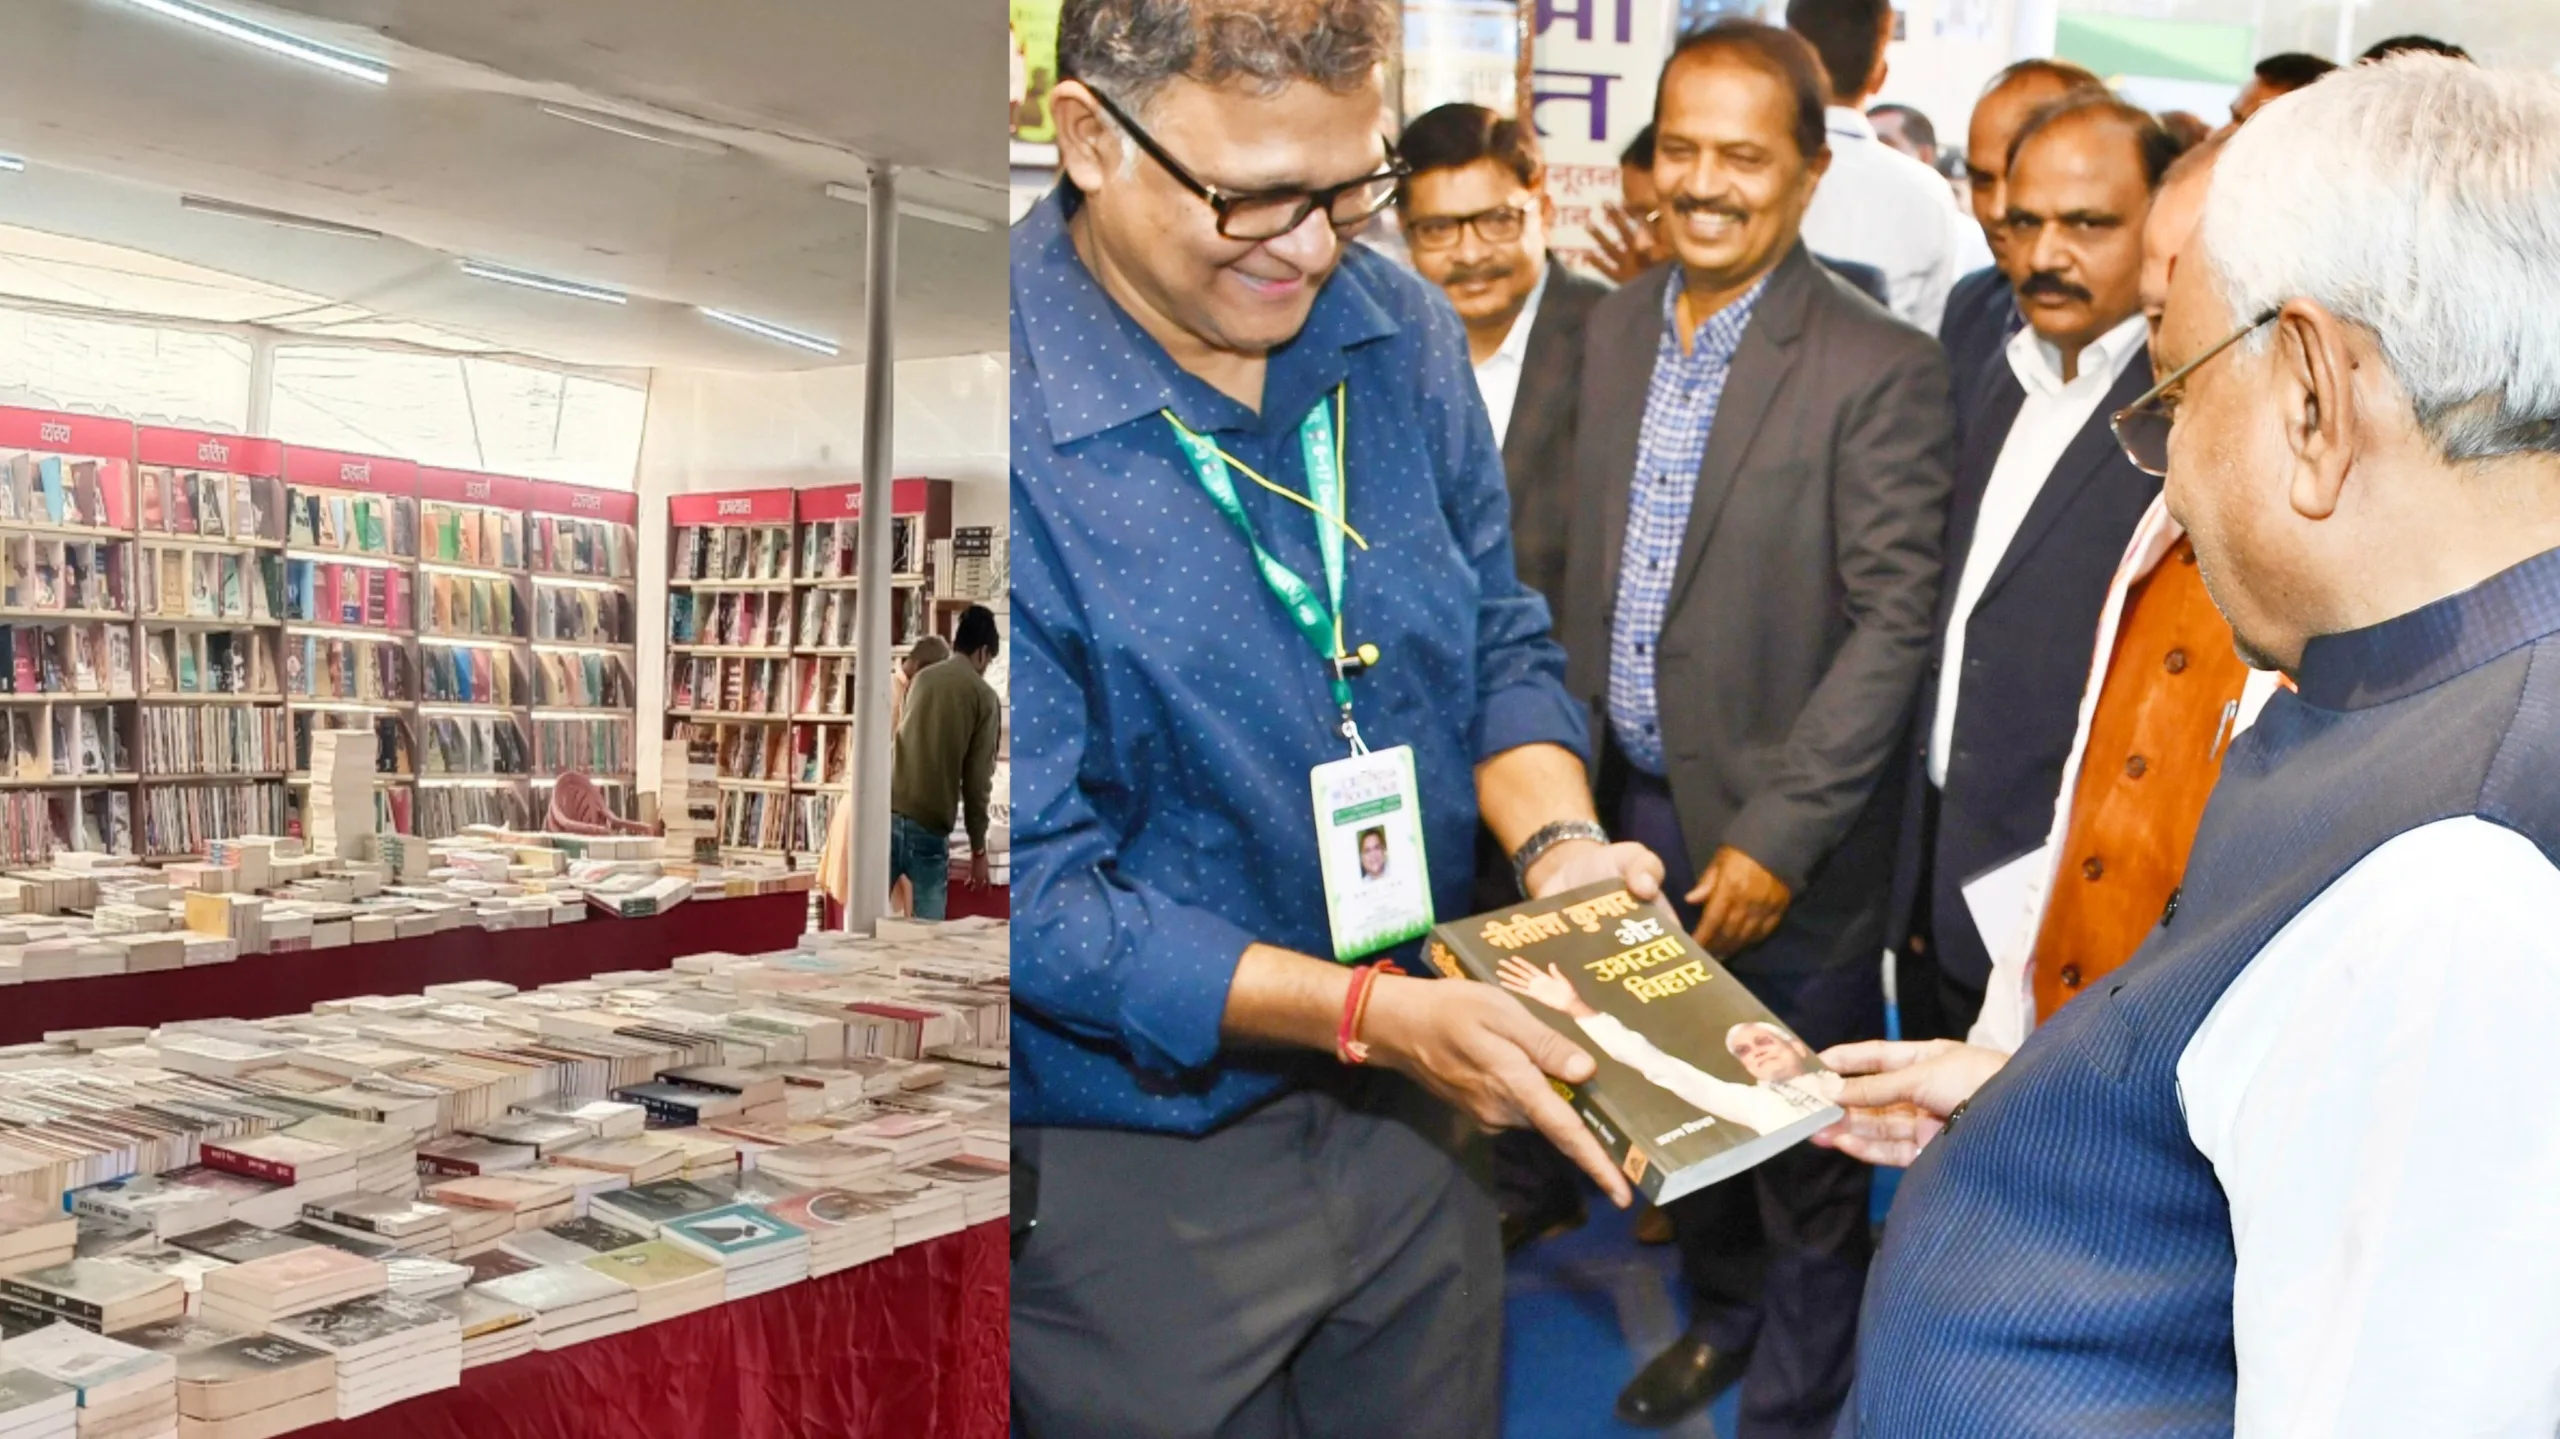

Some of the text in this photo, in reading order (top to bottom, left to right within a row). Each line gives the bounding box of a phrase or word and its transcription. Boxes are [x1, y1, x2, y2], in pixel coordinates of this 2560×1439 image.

[1480, 890, 1640, 950] नीतीश कुमार
[1614, 917, 1665, 945] और
[1583, 935, 1687, 982] उभरता
